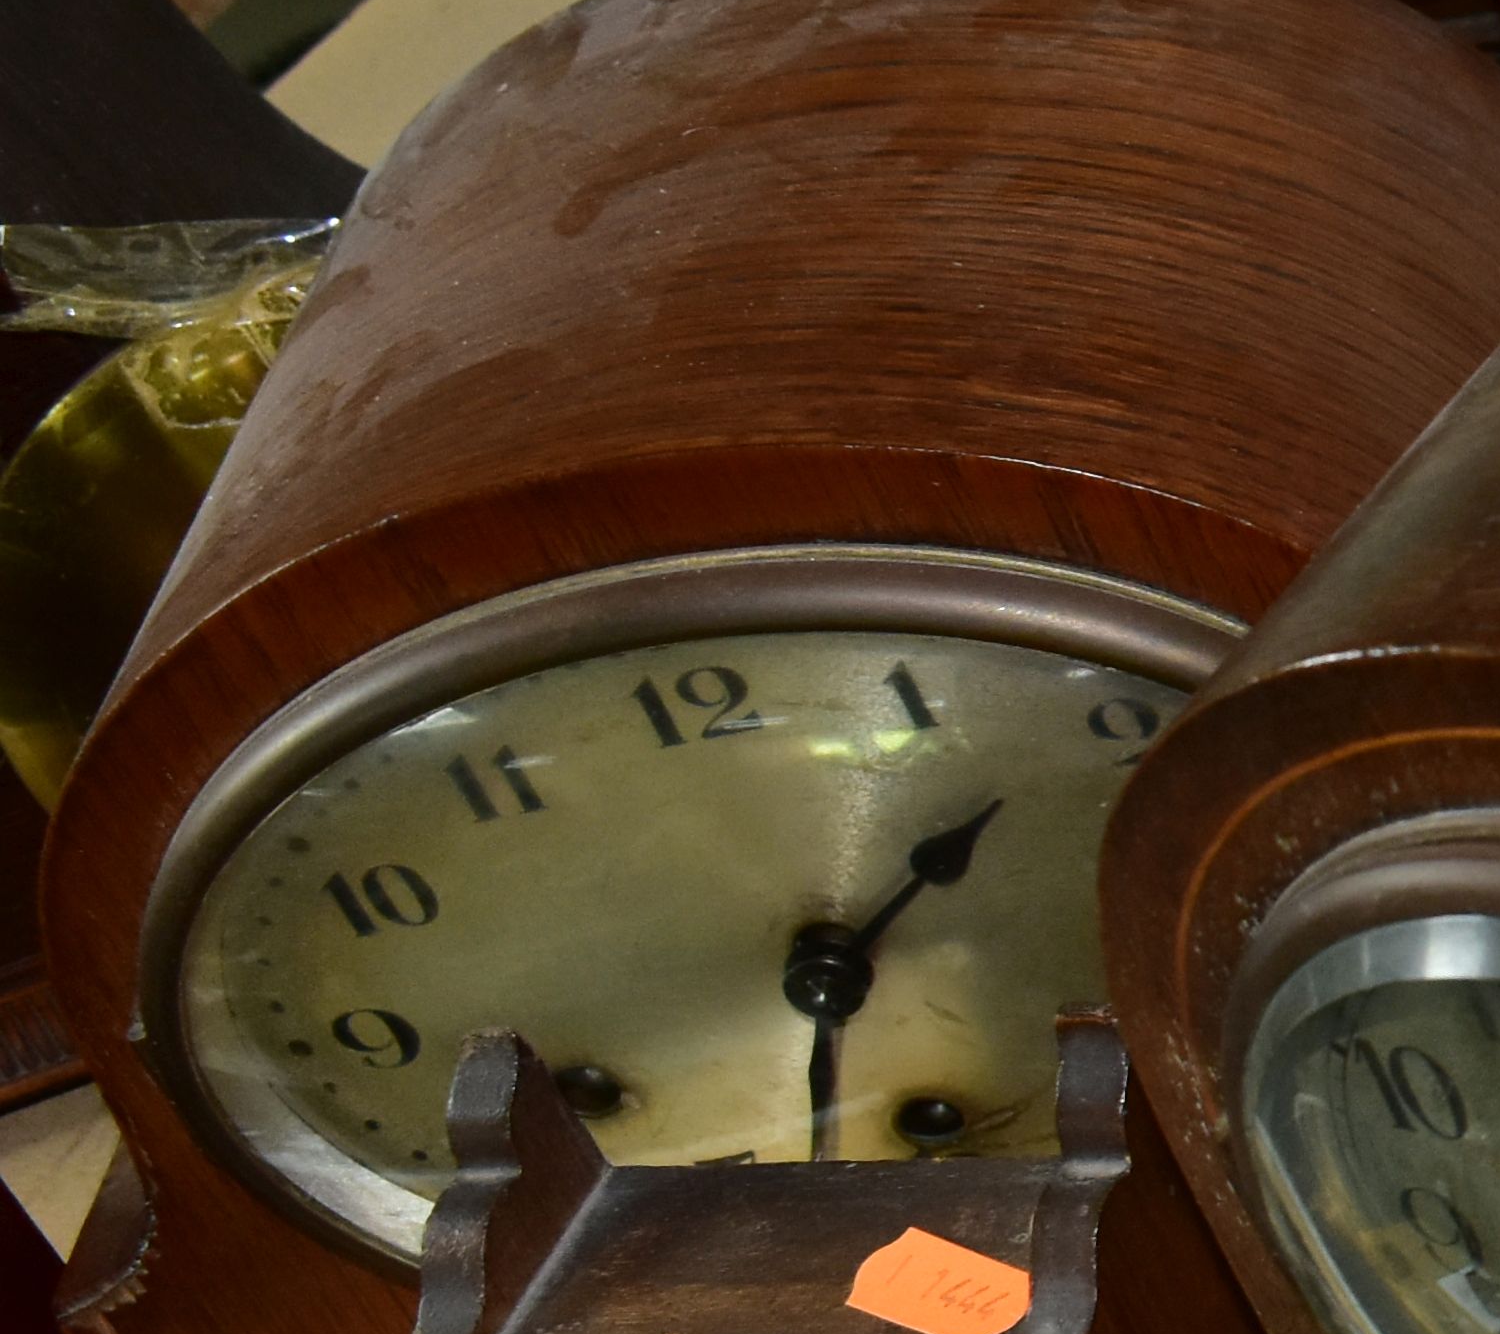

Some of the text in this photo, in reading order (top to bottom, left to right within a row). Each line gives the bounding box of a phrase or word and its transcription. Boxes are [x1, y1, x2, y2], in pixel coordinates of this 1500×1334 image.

[631, 665, 762, 749] 12
[884, 661, 939, 730] 1
[445, 744, 550, 823] 11
[322, 864, 440, 938] 10
[330, 1007, 421, 1069] 9
[1354, 1038, 1467, 1141] 10
